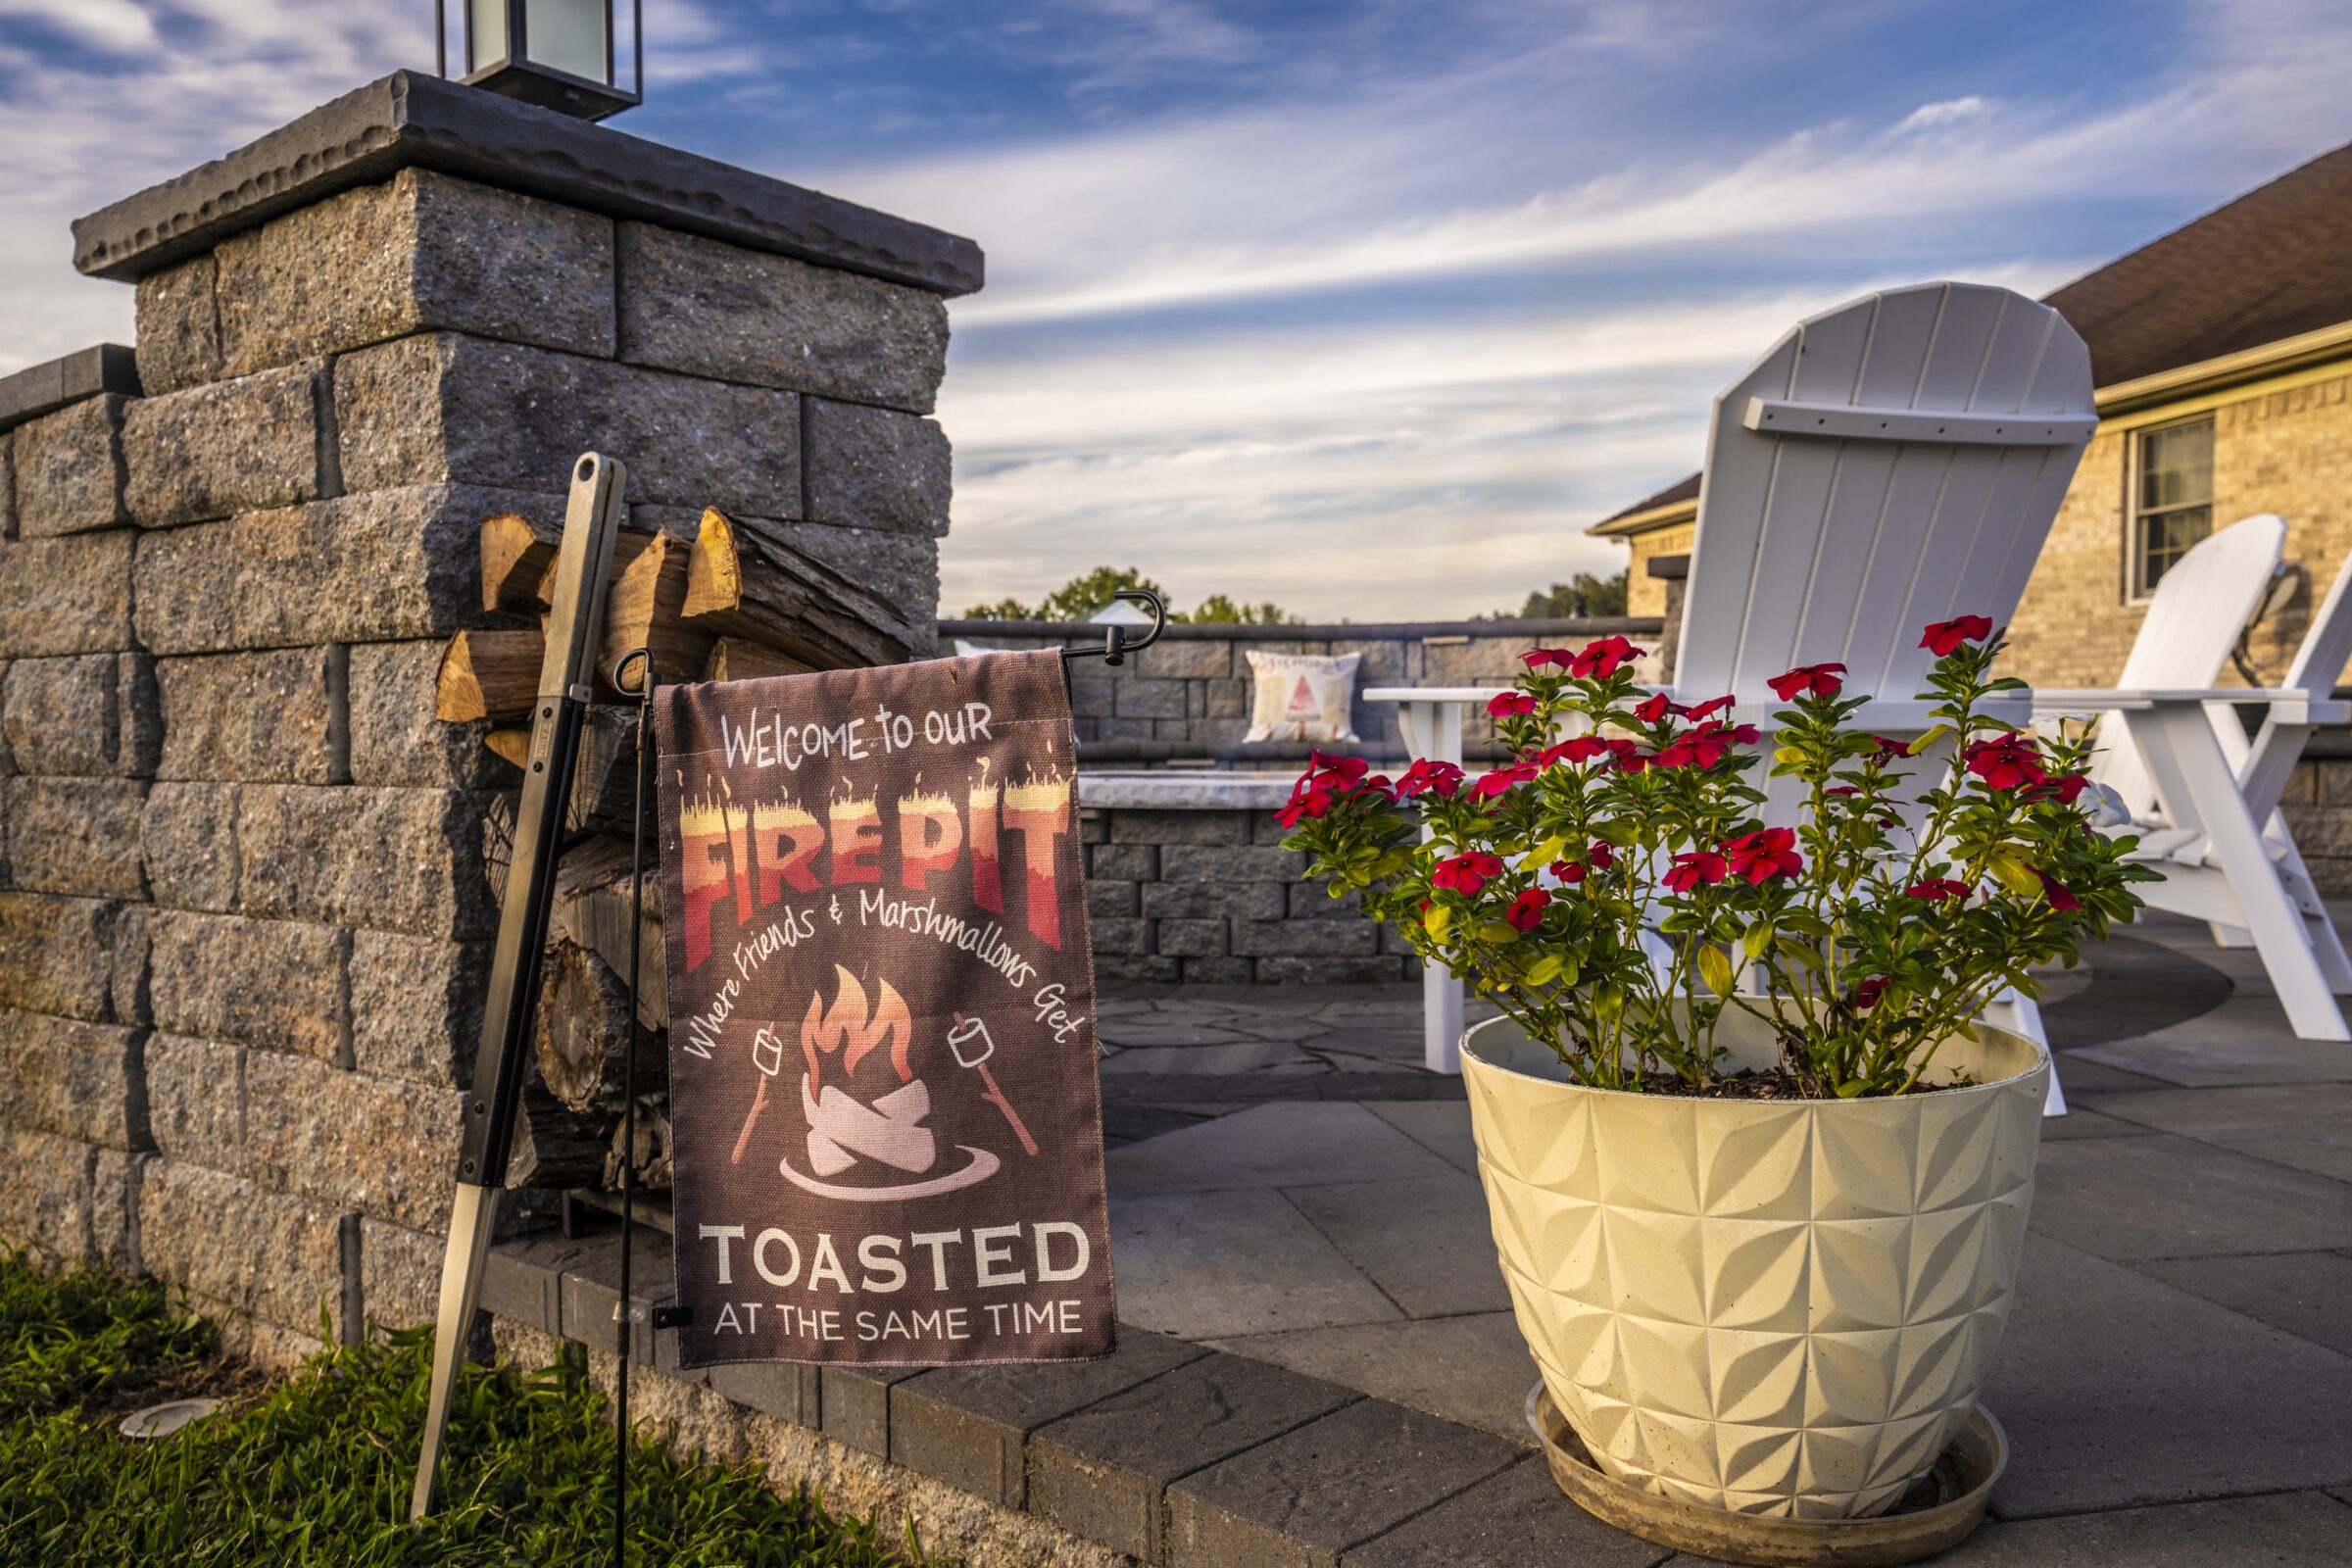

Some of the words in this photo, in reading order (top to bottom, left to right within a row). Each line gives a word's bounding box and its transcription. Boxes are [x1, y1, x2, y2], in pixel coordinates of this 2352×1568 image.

[721, 707, 869, 770] WELCOME
[683, 979, 740, 1059] Where
[733, 905, 815, 981] Friends
[829, 894, 843, 925] &
[859, 888, 1036, 988] Marshmallows
[1034, 983, 1085, 1044] Get
[699, 1221, 1090, 1294] TOASTED
[713, 1301, 762, 1336] AT
[775, 1304, 844, 1341] THE
[858, 1307, 970, 1342] SAME
[984, 1299, 1084, 1336] TIME
